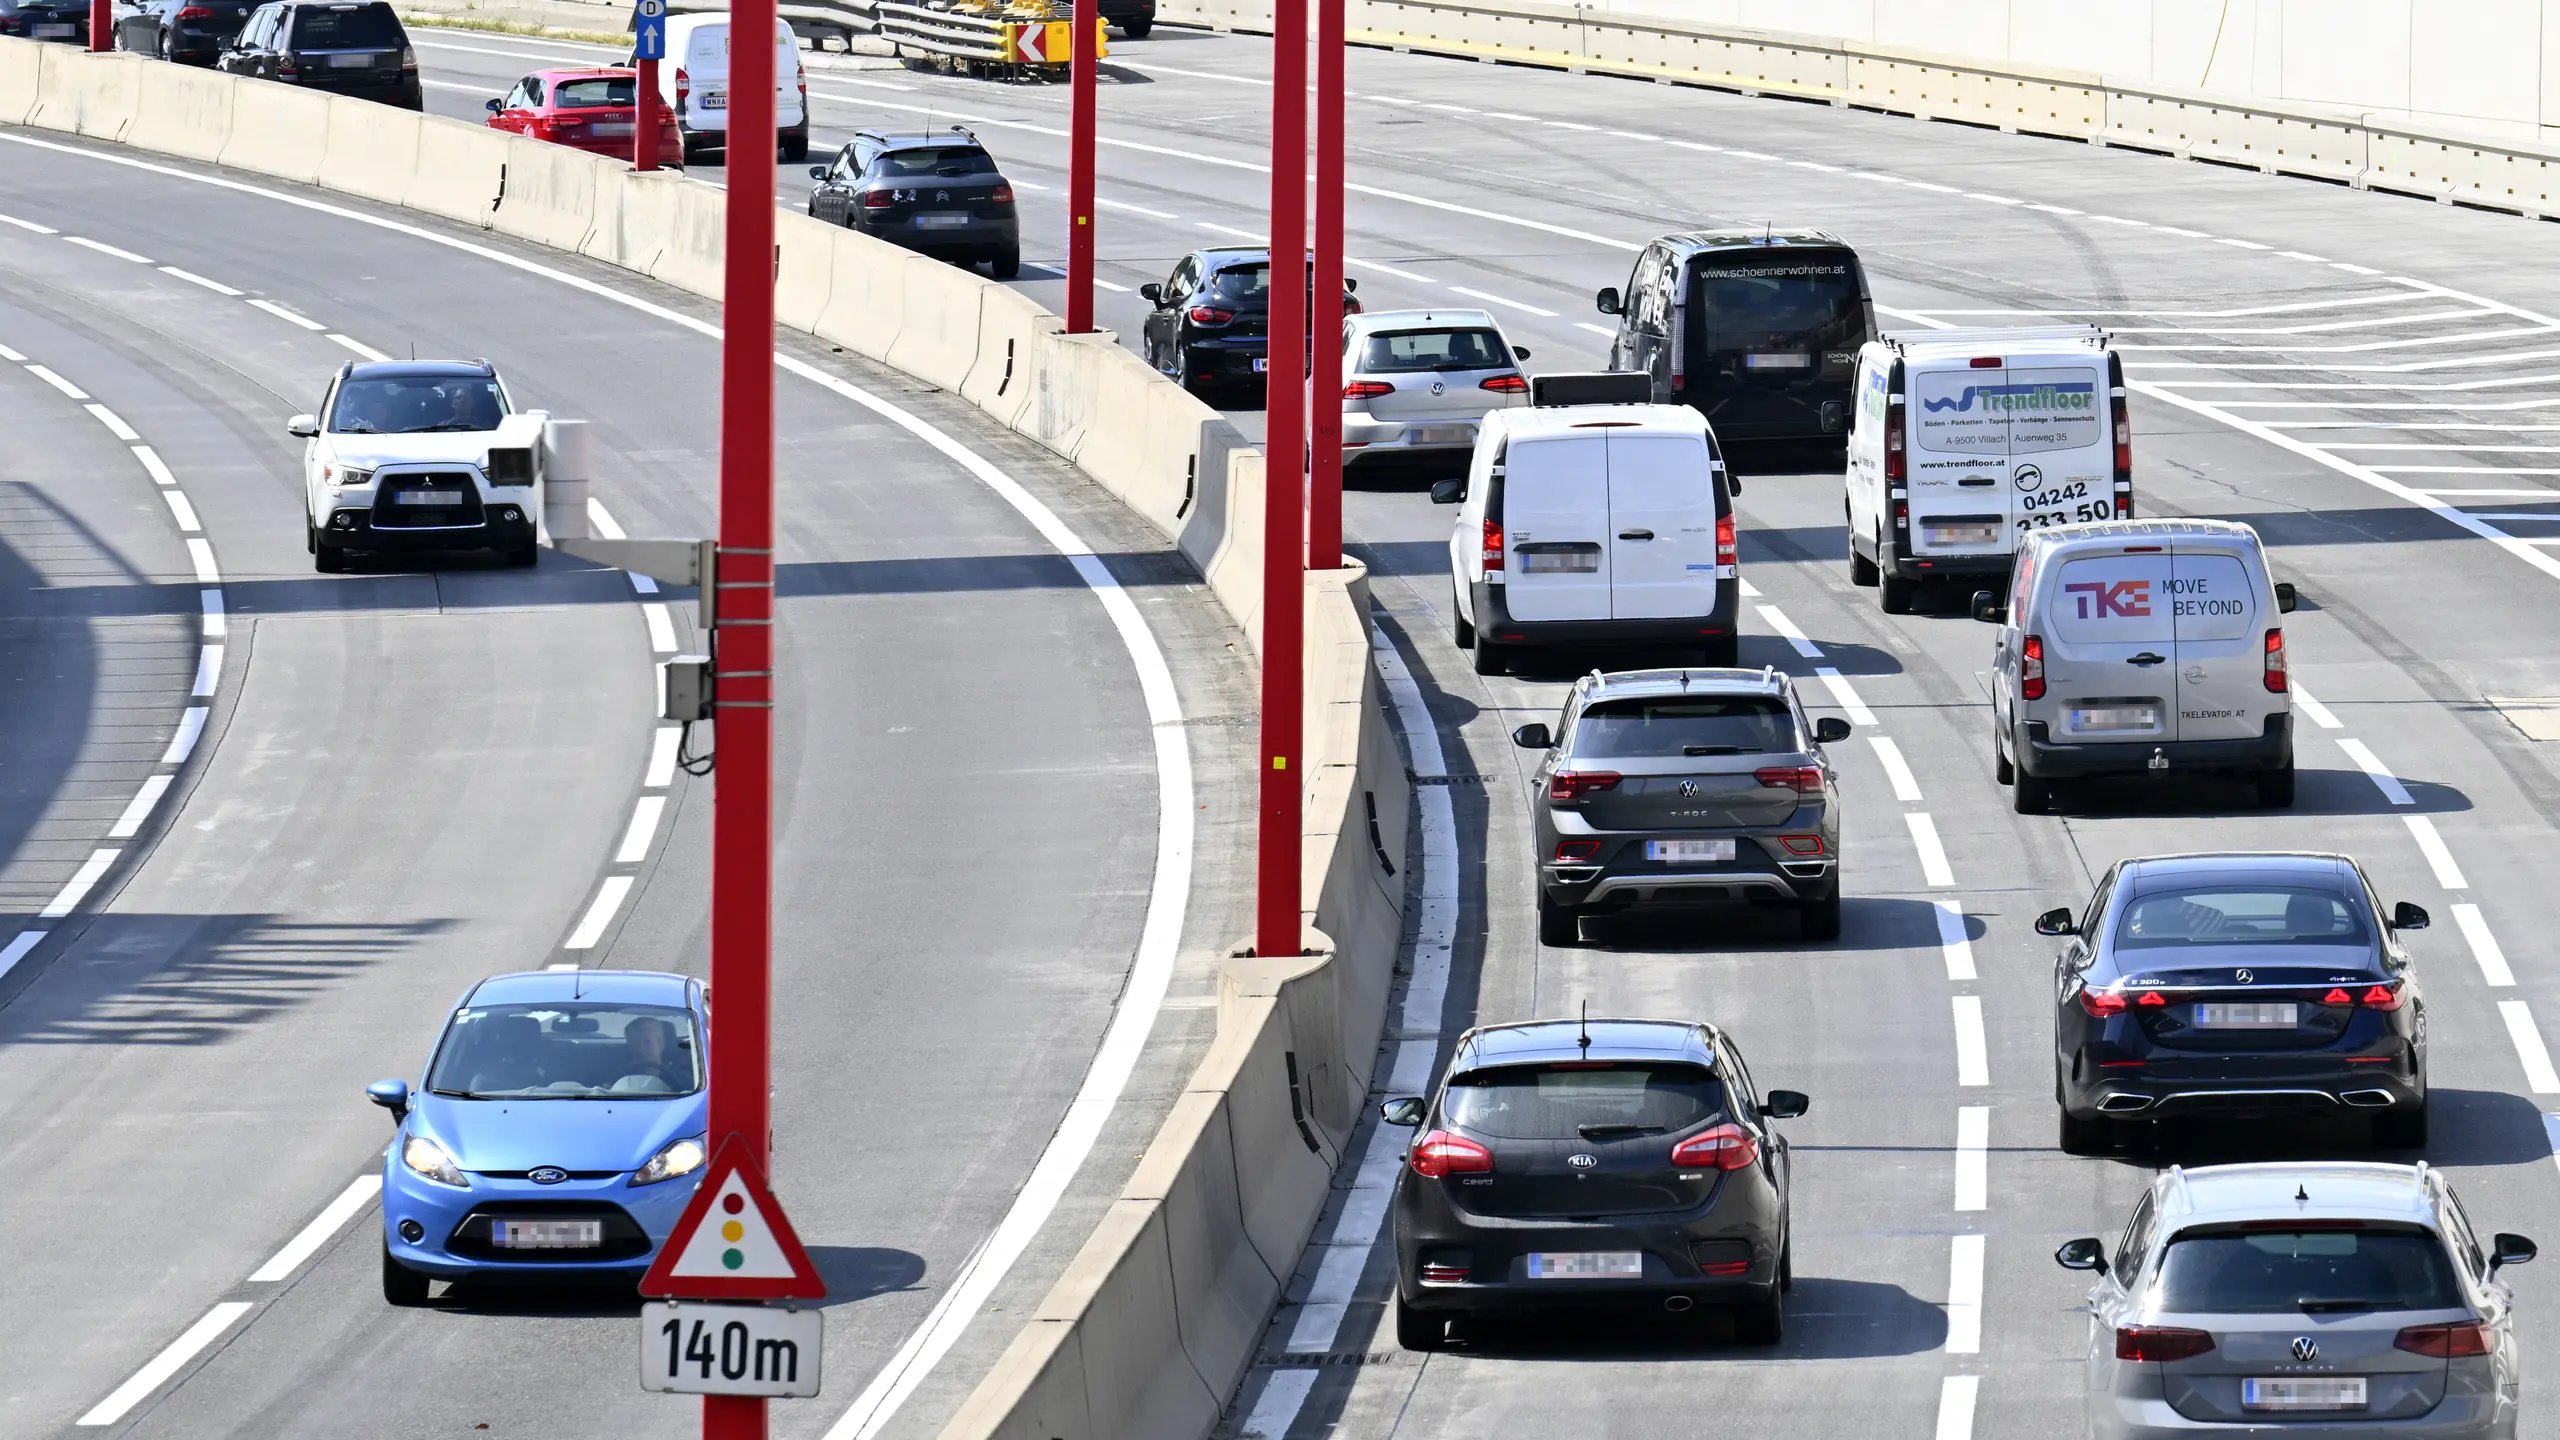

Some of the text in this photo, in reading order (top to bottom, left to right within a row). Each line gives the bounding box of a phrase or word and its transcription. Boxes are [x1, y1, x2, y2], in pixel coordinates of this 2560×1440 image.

[646, 1, 656, 15] D
[1700, 264, 1846, 279] www.schoennerwohnen.at
[1979, 386, 2093, 412] Trendfloor
[2053, 415, 2095, 423] Sonnenschutz
[1945, 433, 2067, 445] A-9500 Villach Auenweg 35
[1920, 459, 2005, 469] www.trendfloor.at
[2023, 482, 2088, 511] 04242
[2077, 499, 2110, 523] 50
[2162, 578, 2208, 594] MOVE
[2065, 580, 2150, 619] TKE
[2174, 599, 2243, 616] BEYOND
[2180, 709, 2246, 719] TKELEVATOR.AT
[1572, 1157, 1592, 1166] KIA
